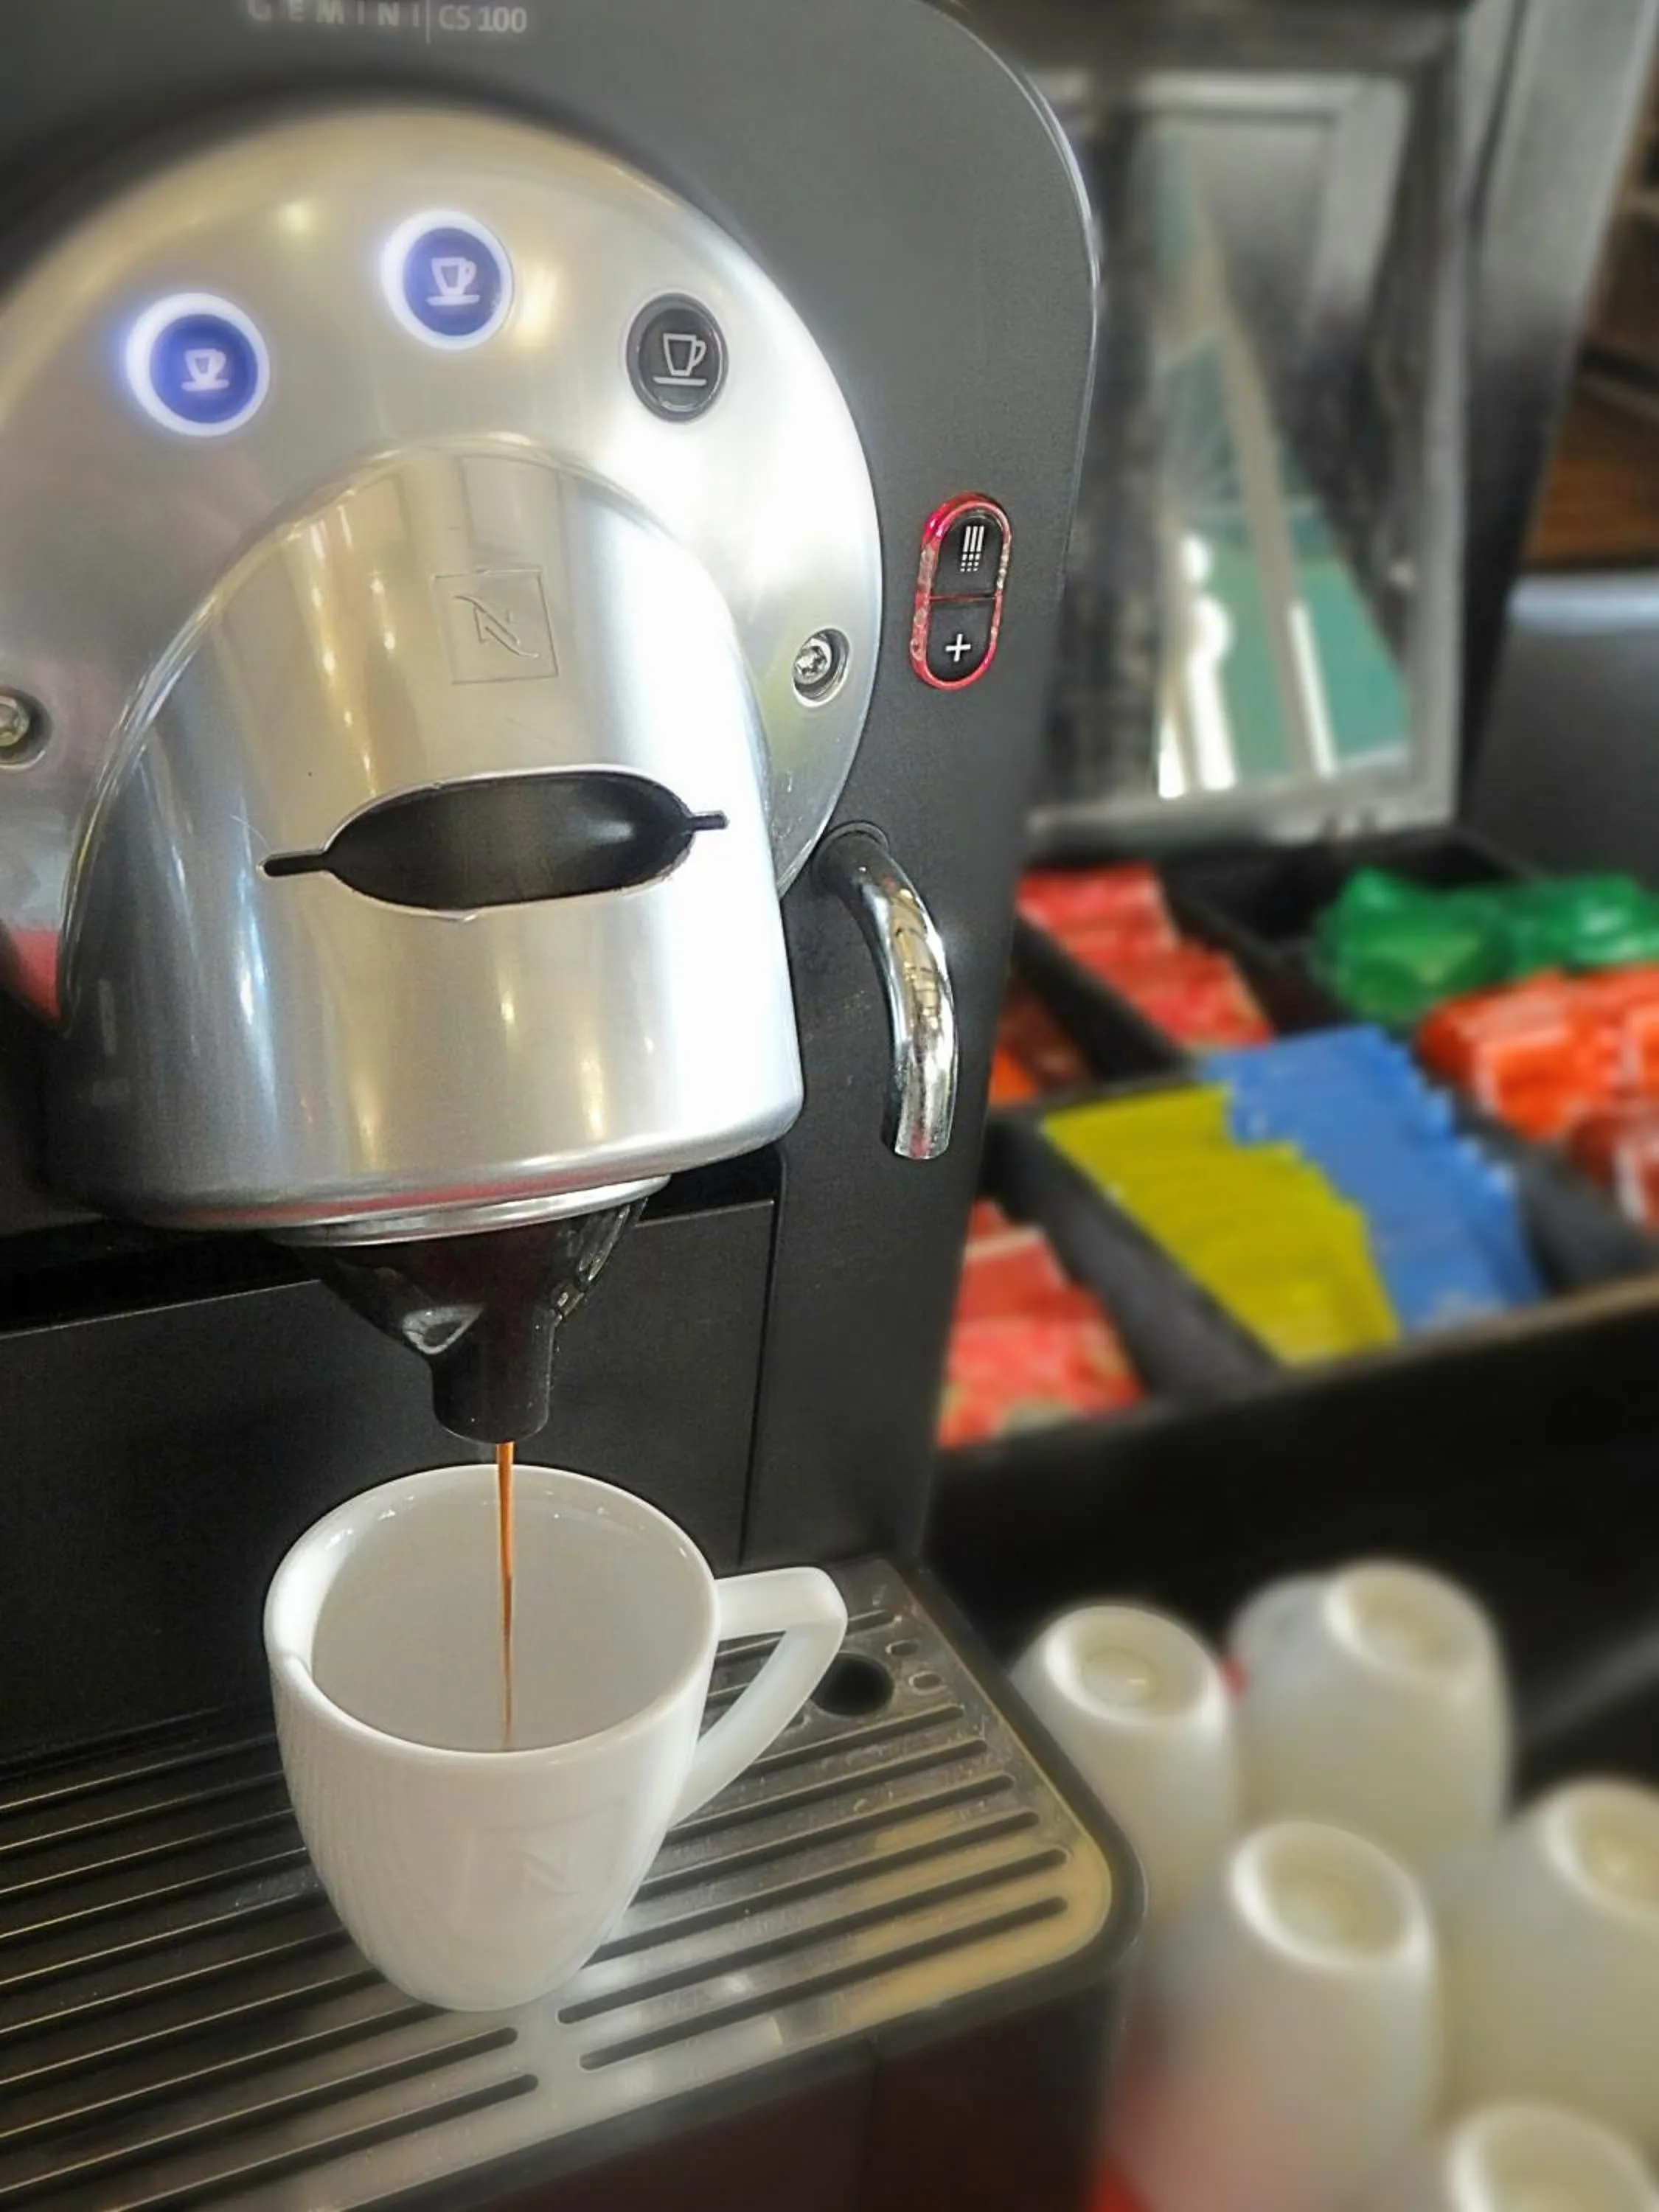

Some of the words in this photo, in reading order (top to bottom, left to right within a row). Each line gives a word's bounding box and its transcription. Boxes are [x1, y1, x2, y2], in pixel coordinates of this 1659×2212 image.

[247, 0, 420, 27] GEMINI
[439, 4, 471, 31] CS
[477, 6, 528, 33] 100
